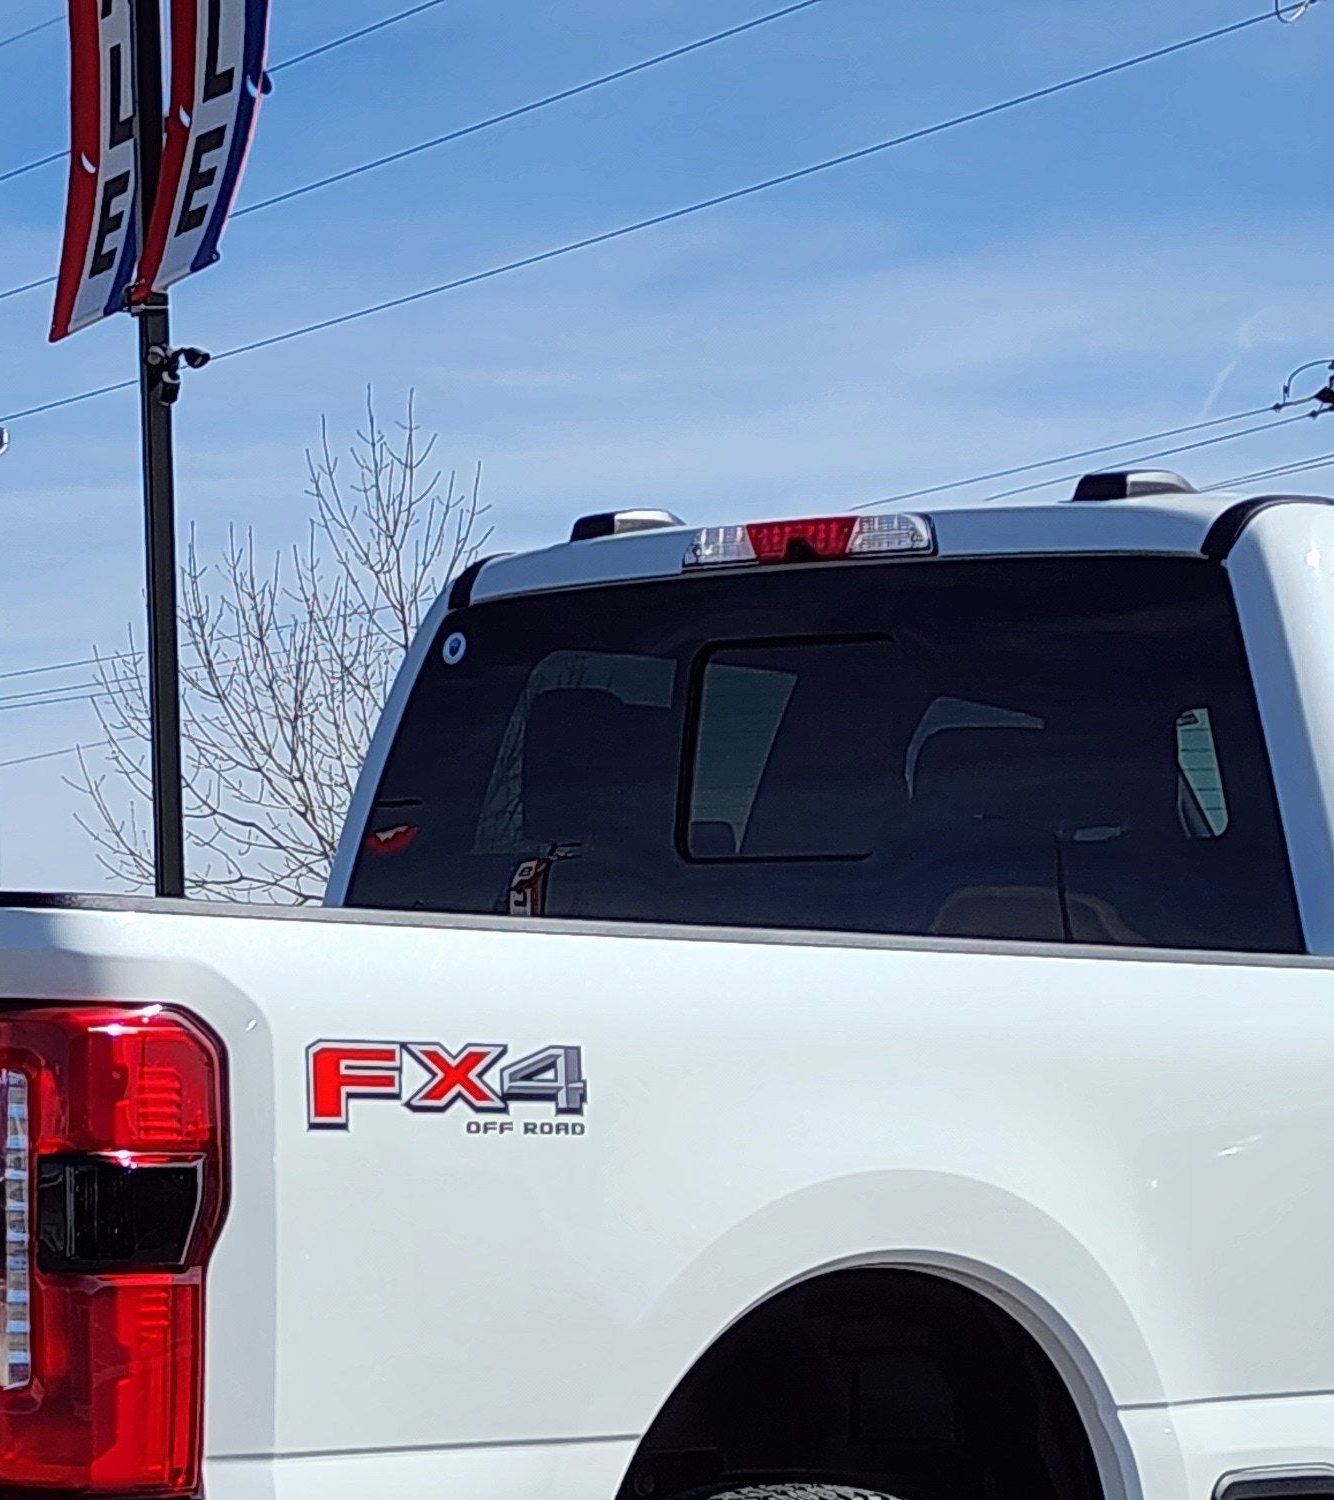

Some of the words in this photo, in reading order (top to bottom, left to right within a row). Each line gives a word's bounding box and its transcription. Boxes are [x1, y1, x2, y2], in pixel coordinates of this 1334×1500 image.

[305, 1038, 588, 1132] FX4
[466, 1120, 514, 1135] OFF
[523, 1121, 586, 1136] ROAD
